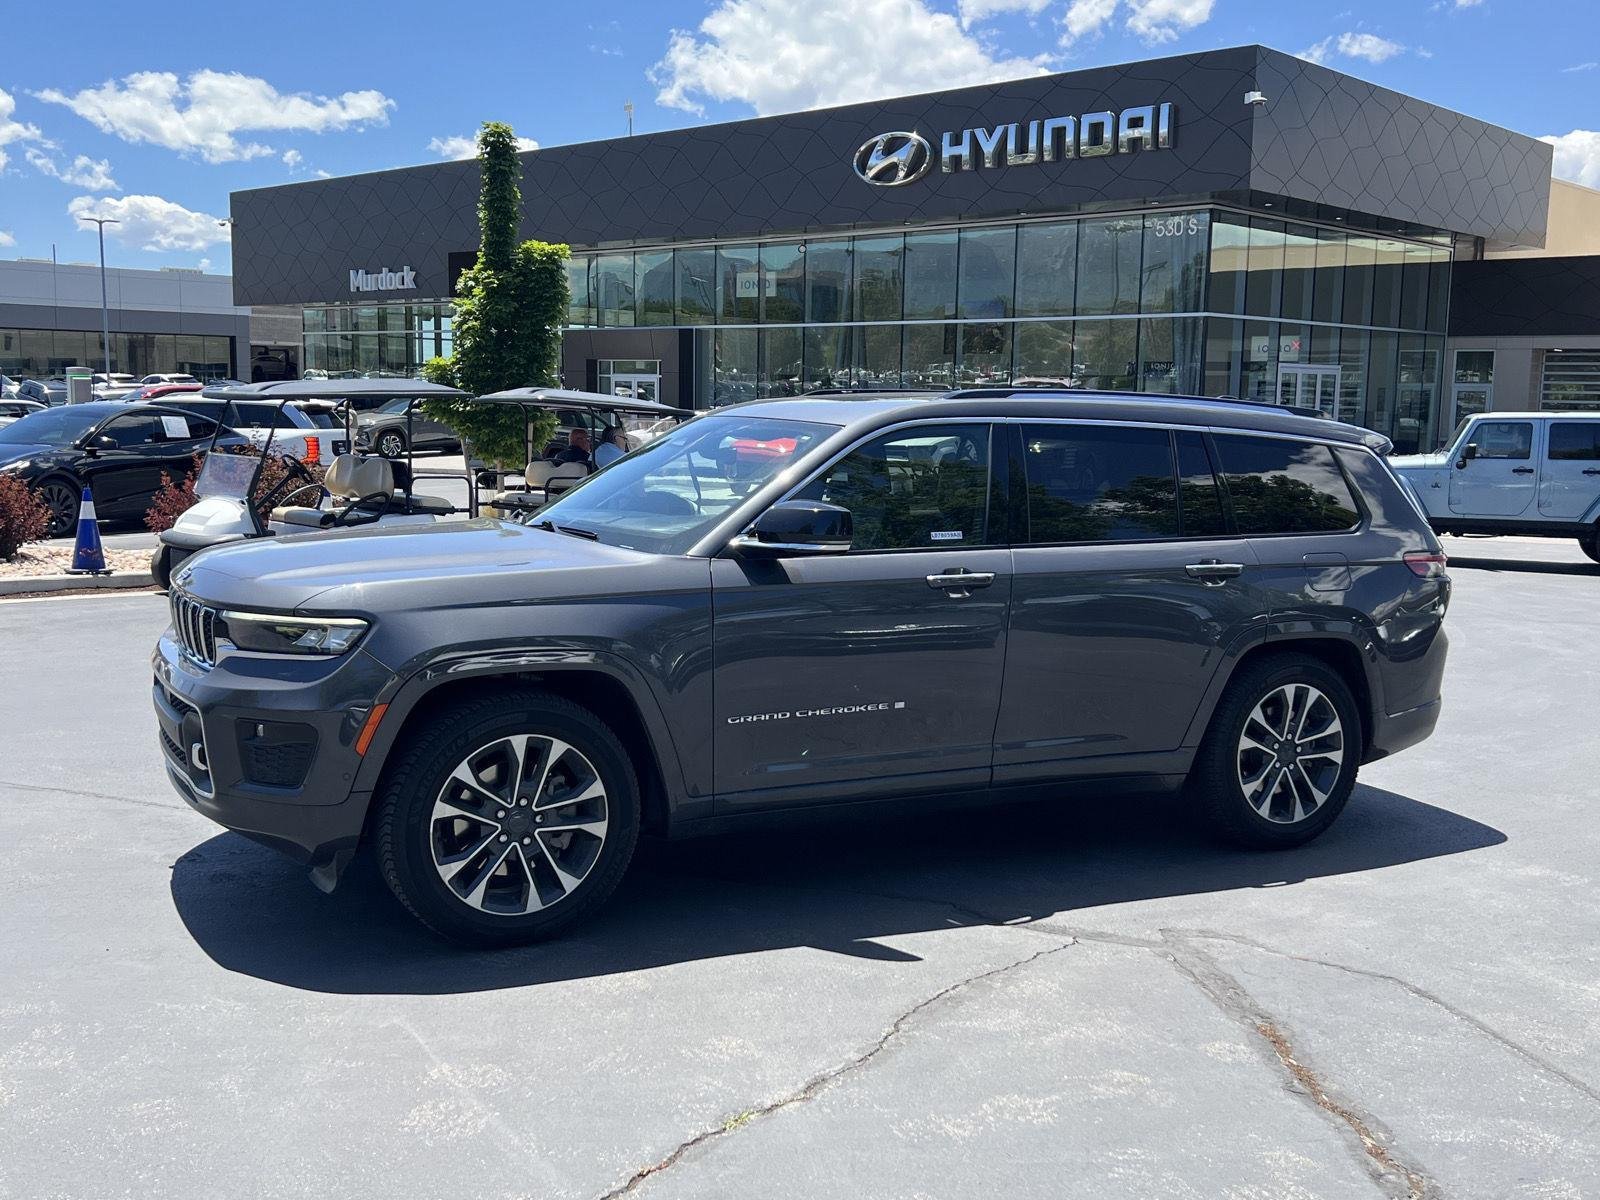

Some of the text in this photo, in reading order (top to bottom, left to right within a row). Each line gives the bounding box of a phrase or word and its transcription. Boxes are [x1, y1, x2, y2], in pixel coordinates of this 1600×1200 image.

[941, 102, 1174, 173] HYUNDAI
[1155, 218, 1198, 237] 530 S
[349, 265, 417, 292] Murdock
[727, 711, 790, 724] GRAND
[795, 702, 889, 718] CHEROKEE
